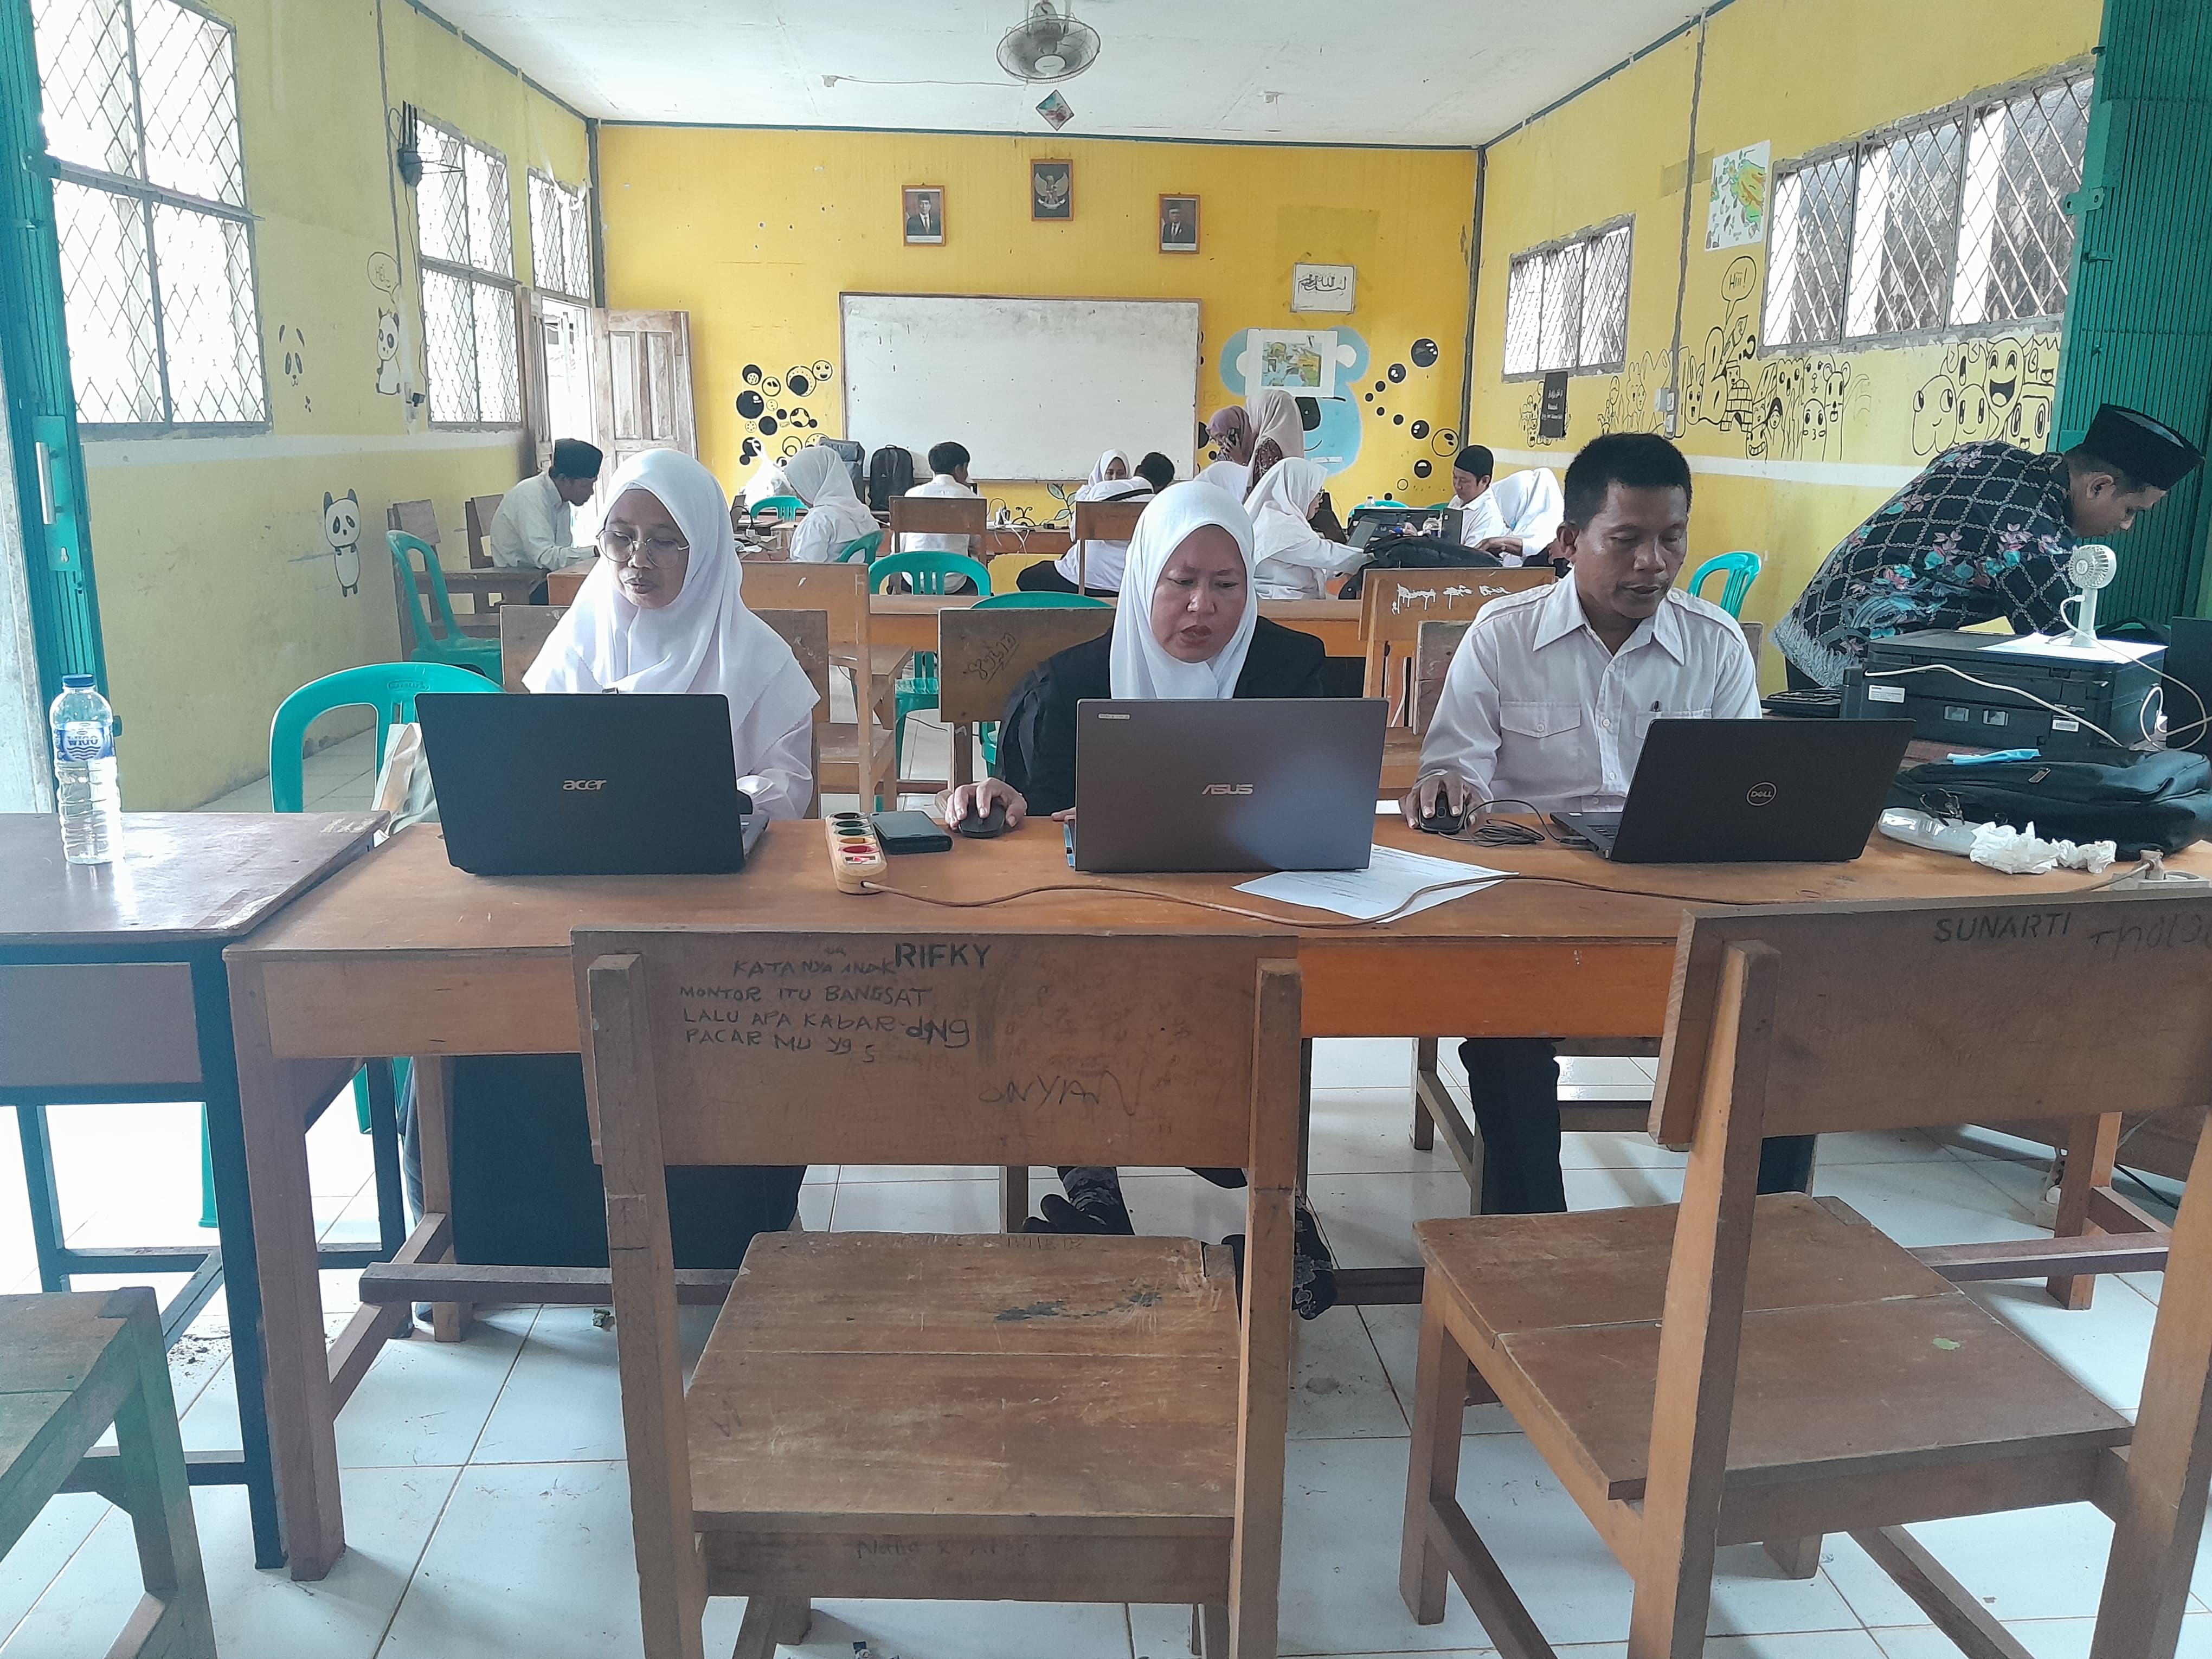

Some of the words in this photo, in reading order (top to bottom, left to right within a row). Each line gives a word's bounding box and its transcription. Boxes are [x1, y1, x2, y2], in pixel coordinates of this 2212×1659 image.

[563, 780, 607, 790] acer
[1201, 784, 1253, 795] ASUS
[1934, 911, 2072, 943] SUNARTI
[894, 942, 991, 969] RIFKY
[778, 986, 812, 1000] ITU
[824, 984, 933, 1008] BANGSAT
[683, 1007, 739, 1024] LALU
[751, 1011, 790, 1028] APA
[686, 1029, 762, 1046] PACAR
